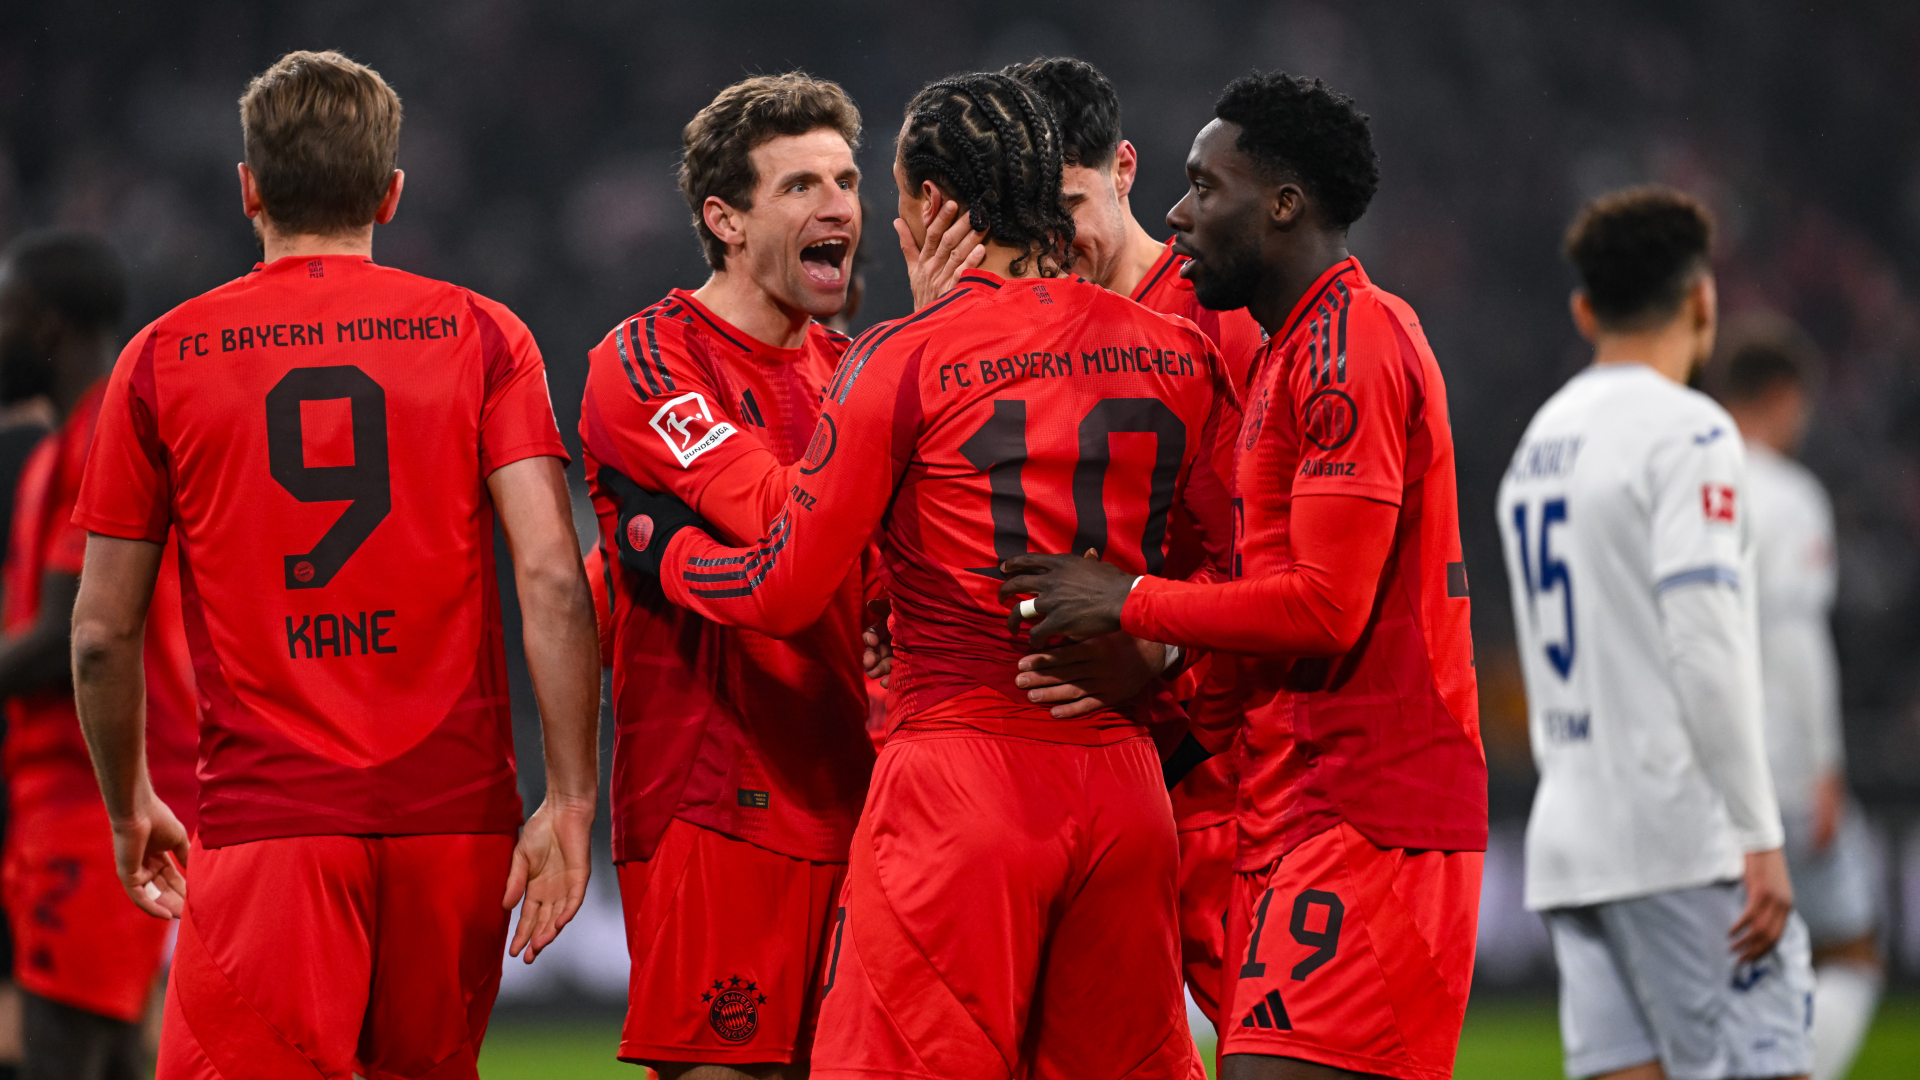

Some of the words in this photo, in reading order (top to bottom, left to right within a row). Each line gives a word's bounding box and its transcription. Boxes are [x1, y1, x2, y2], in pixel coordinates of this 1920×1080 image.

[179, 332, 210, 361] FC
[221, 322, 324, 353] BAYERN
[336, 314, 458, 343] MÜNCHEN
[939, 362, 972, 392] FC
[980, 351, 1073, 385] BAYERN
[1081, 346, 1195, 377] MÜNCHEN
[683, 425, 730, 460] BUNDESLIGA
[265, 365, 392, 590] 9
[957, 397, 1187, 581] 10
[1299, 458, 1357, 477] Allianz
[1512, 497, 1576, 684] 15
[285, 609, 398, 659] KANE
[1239, 887, 1345, 982] 19
[723, 993, 755, 1014] BAYERN
